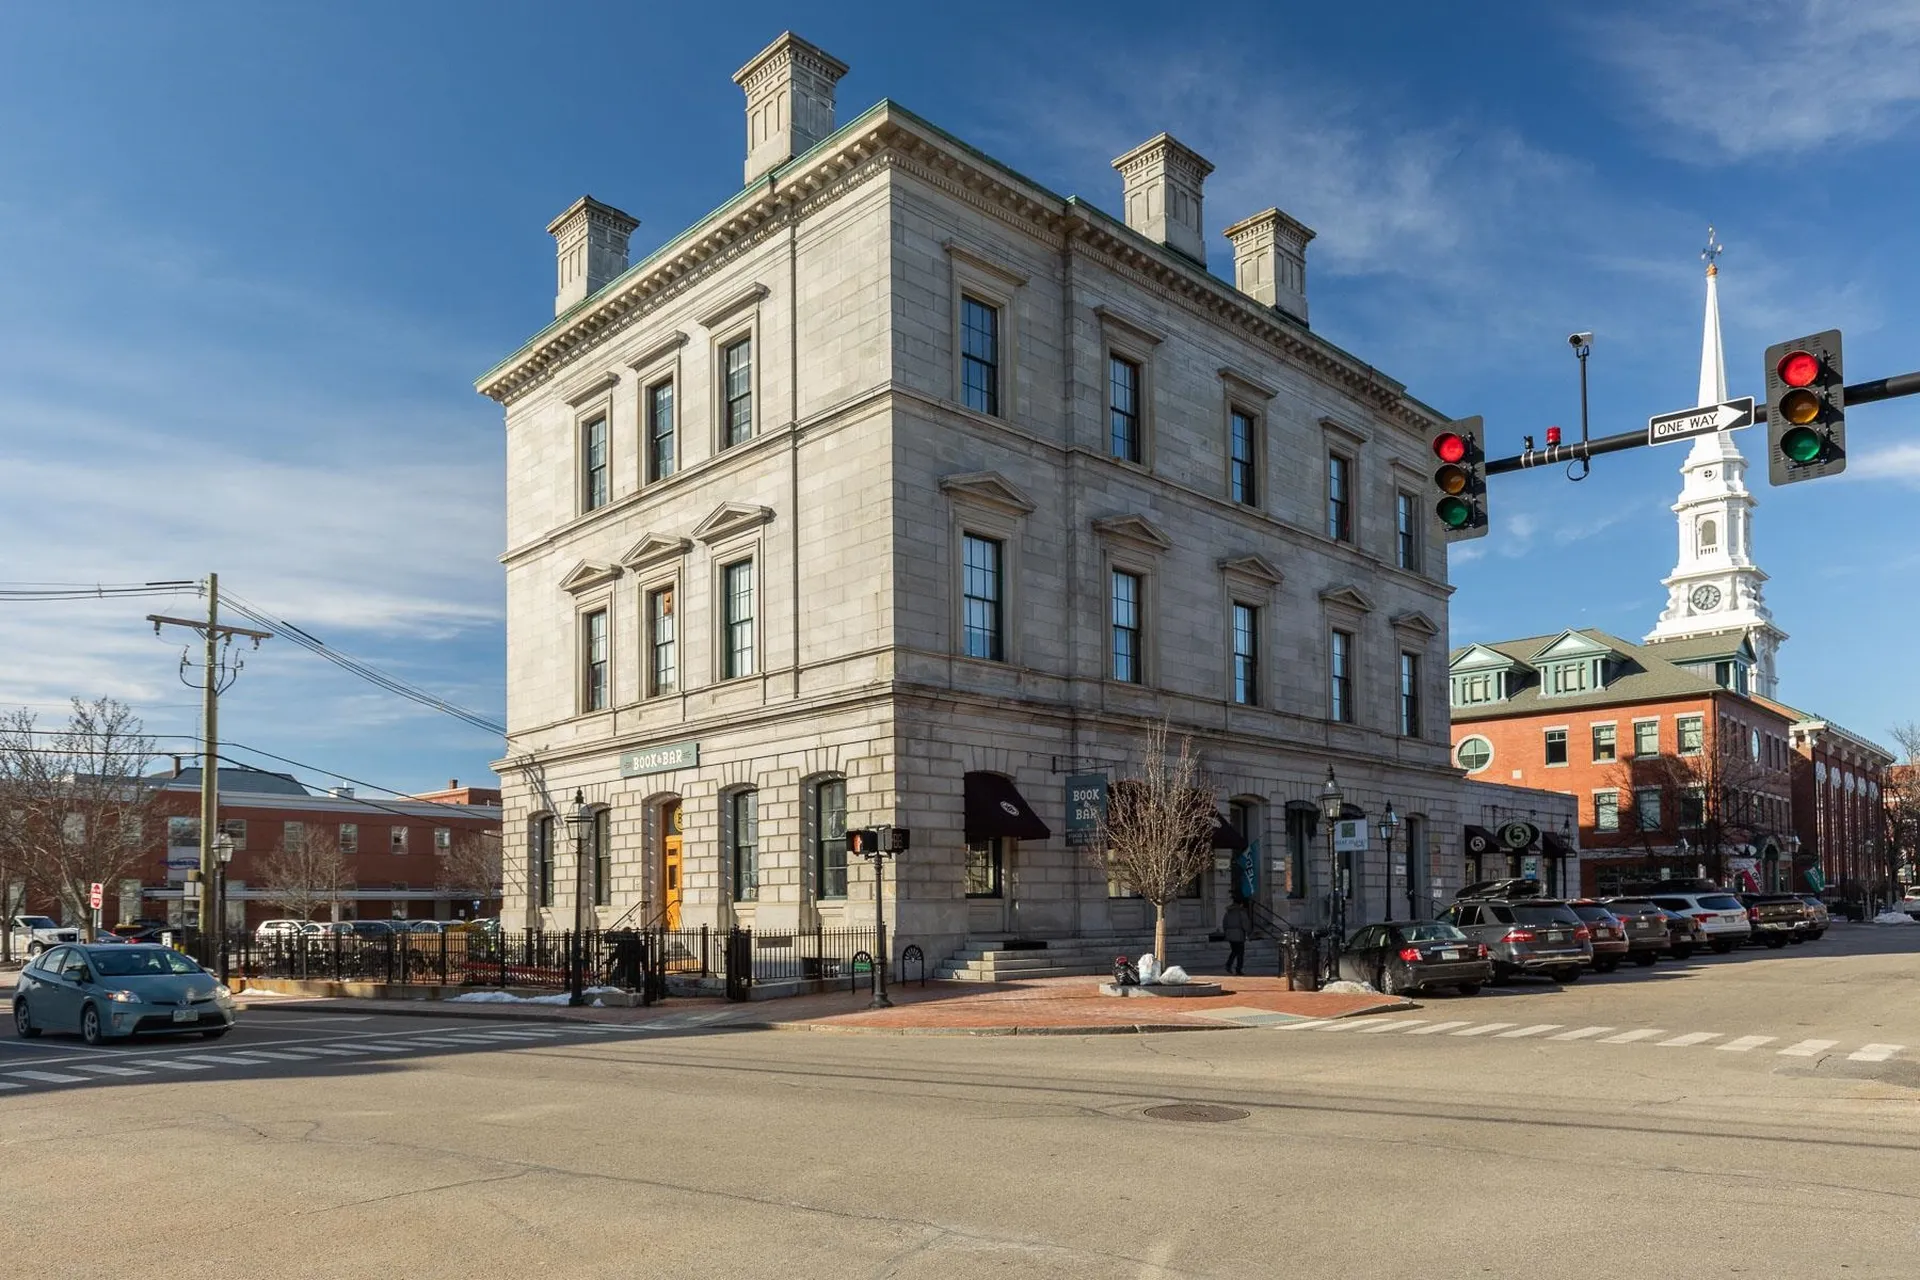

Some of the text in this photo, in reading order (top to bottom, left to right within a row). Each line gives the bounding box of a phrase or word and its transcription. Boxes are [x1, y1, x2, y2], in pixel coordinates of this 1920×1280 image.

[1658, 413, 1718, 435] ONE WAY
[633, 753, 657, 771] BOOK
[662, 749, 683, 766] BAR
[1073, 788, 1100, 801] BOOK
[1075, 808, 1098, 820] BAR
[1512, 827, 1525, 843] 5
[1475, 839, 1481, 847] 5
